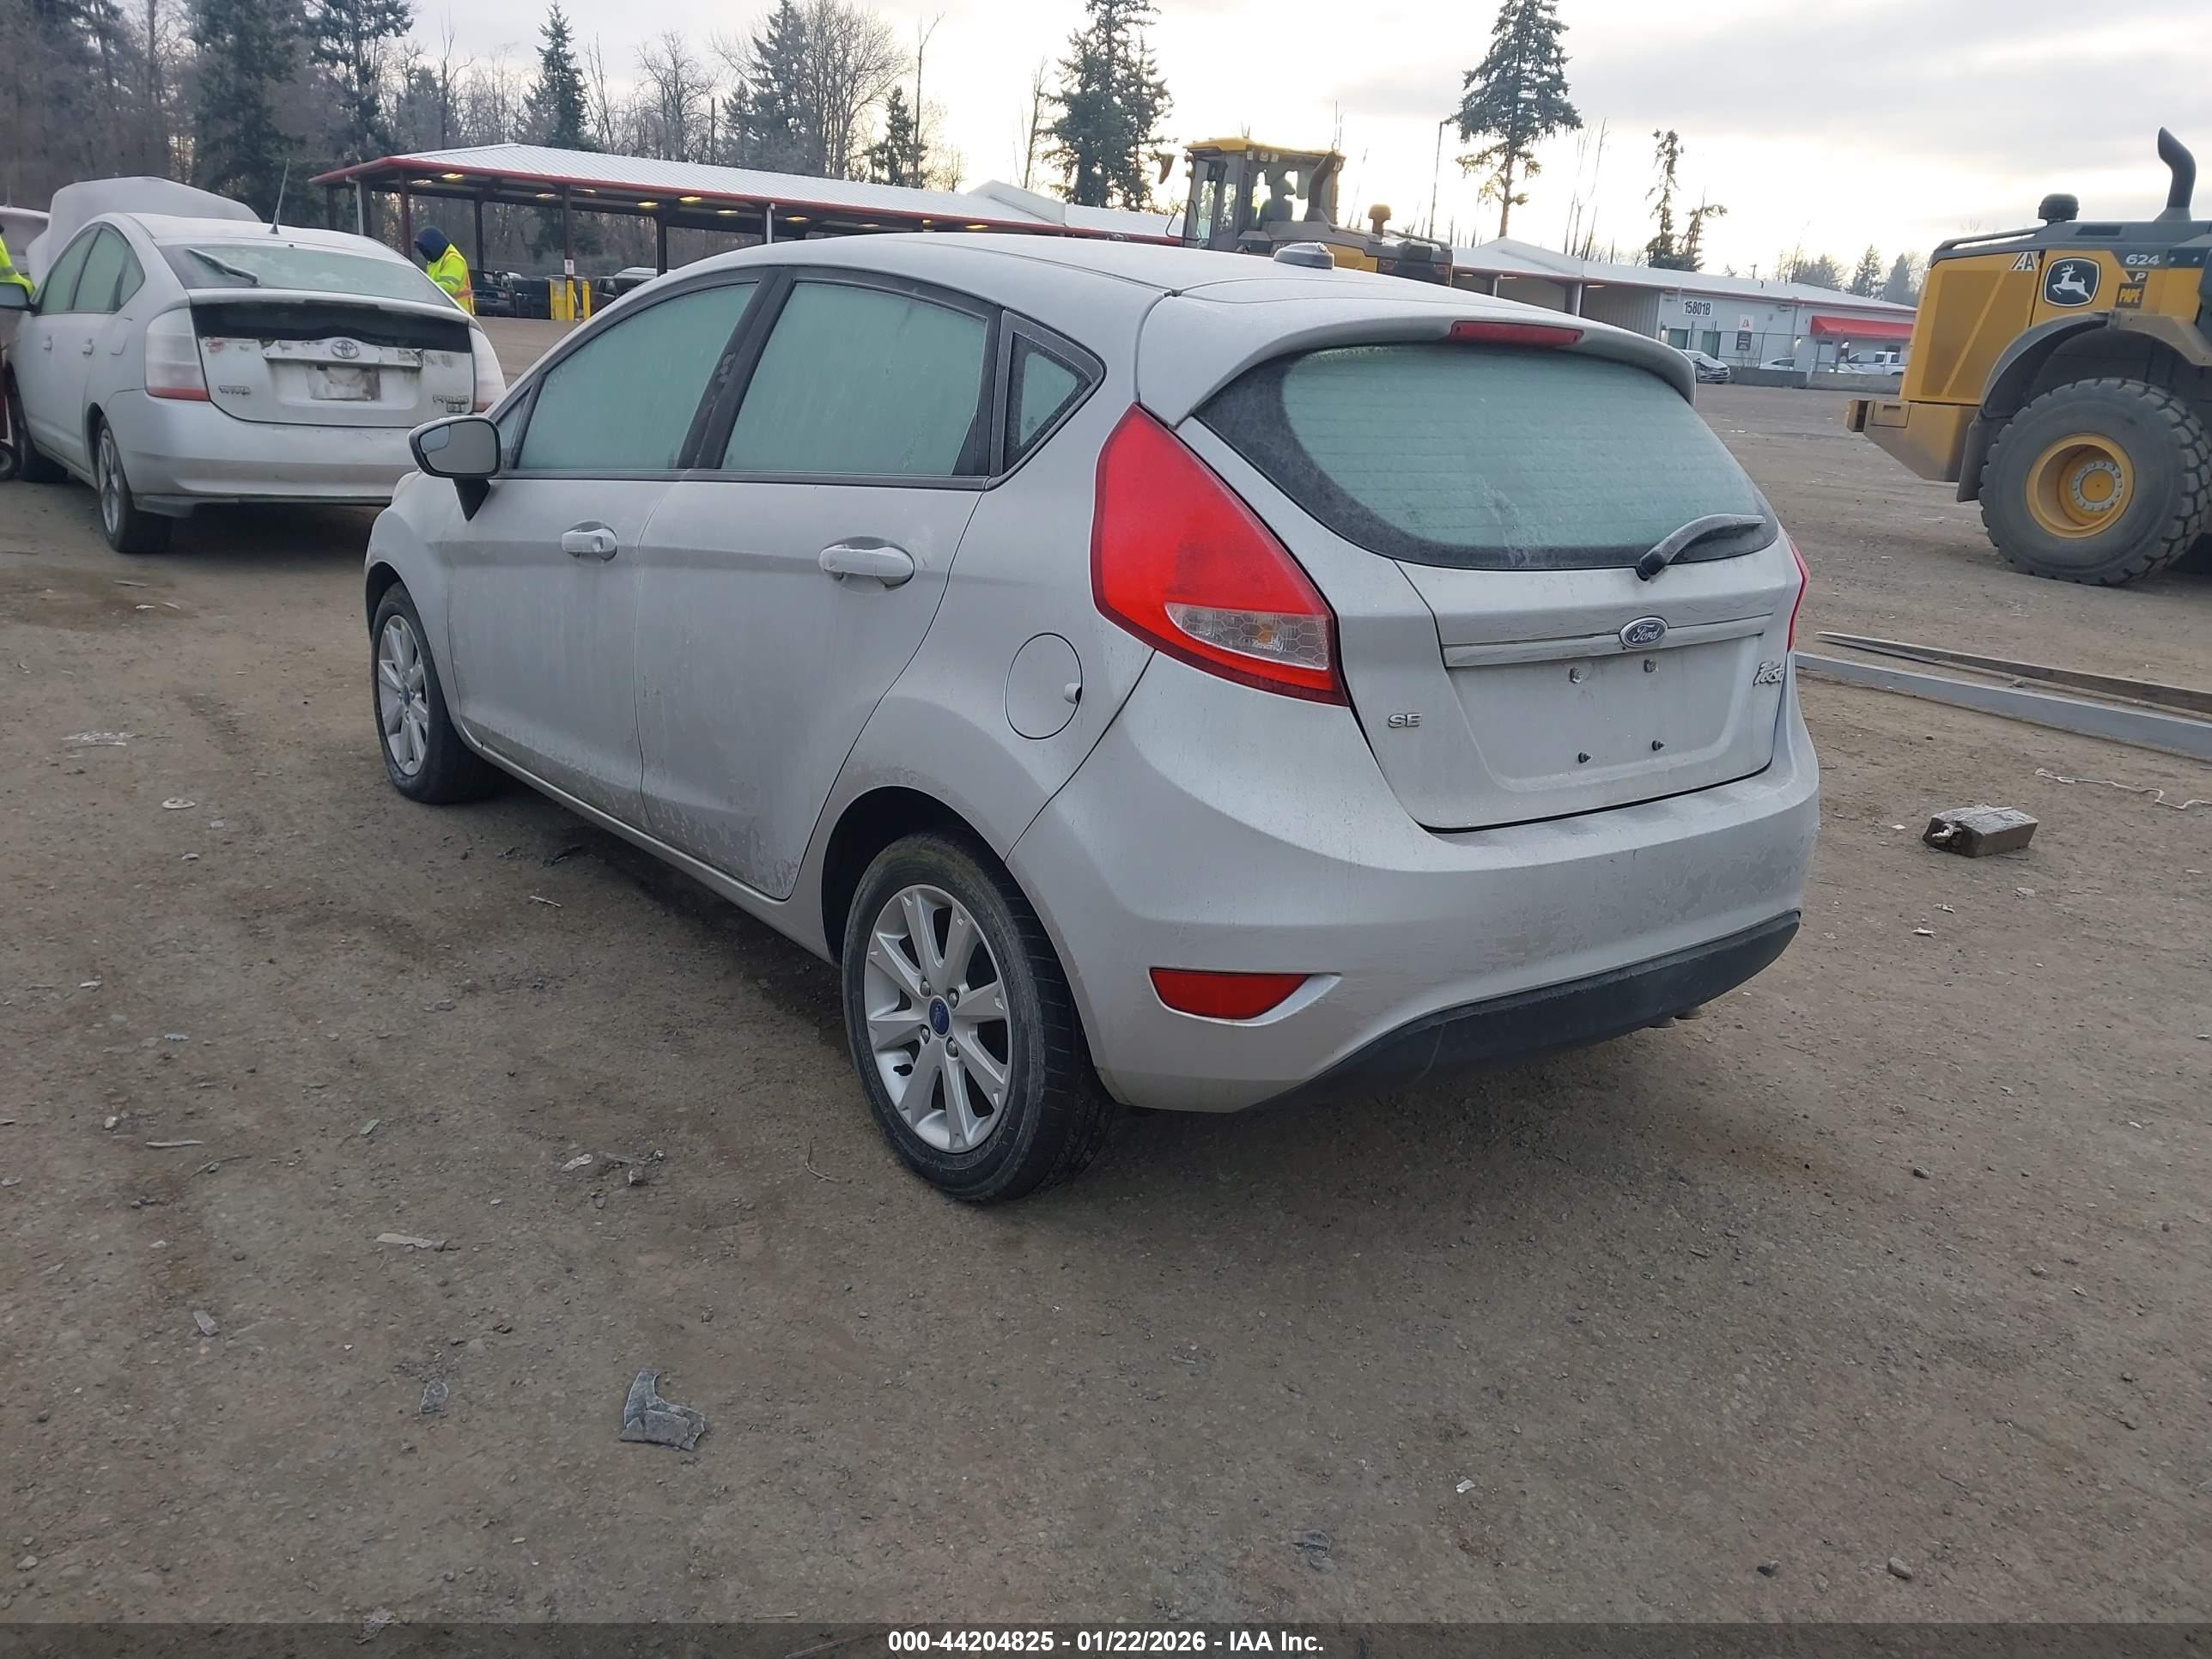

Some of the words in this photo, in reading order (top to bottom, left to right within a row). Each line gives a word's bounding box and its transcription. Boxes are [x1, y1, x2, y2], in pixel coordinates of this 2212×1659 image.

[2125, 253, 2160, 265] 624
[2135, 271, 2147, 282] P
[1684, 301, 1711, 316] 15801B
[1632, 623, 1661, 642] Ford
[1753, 661, 1785, 686] Fiest
[1388, 713, 1422, 728] SE
